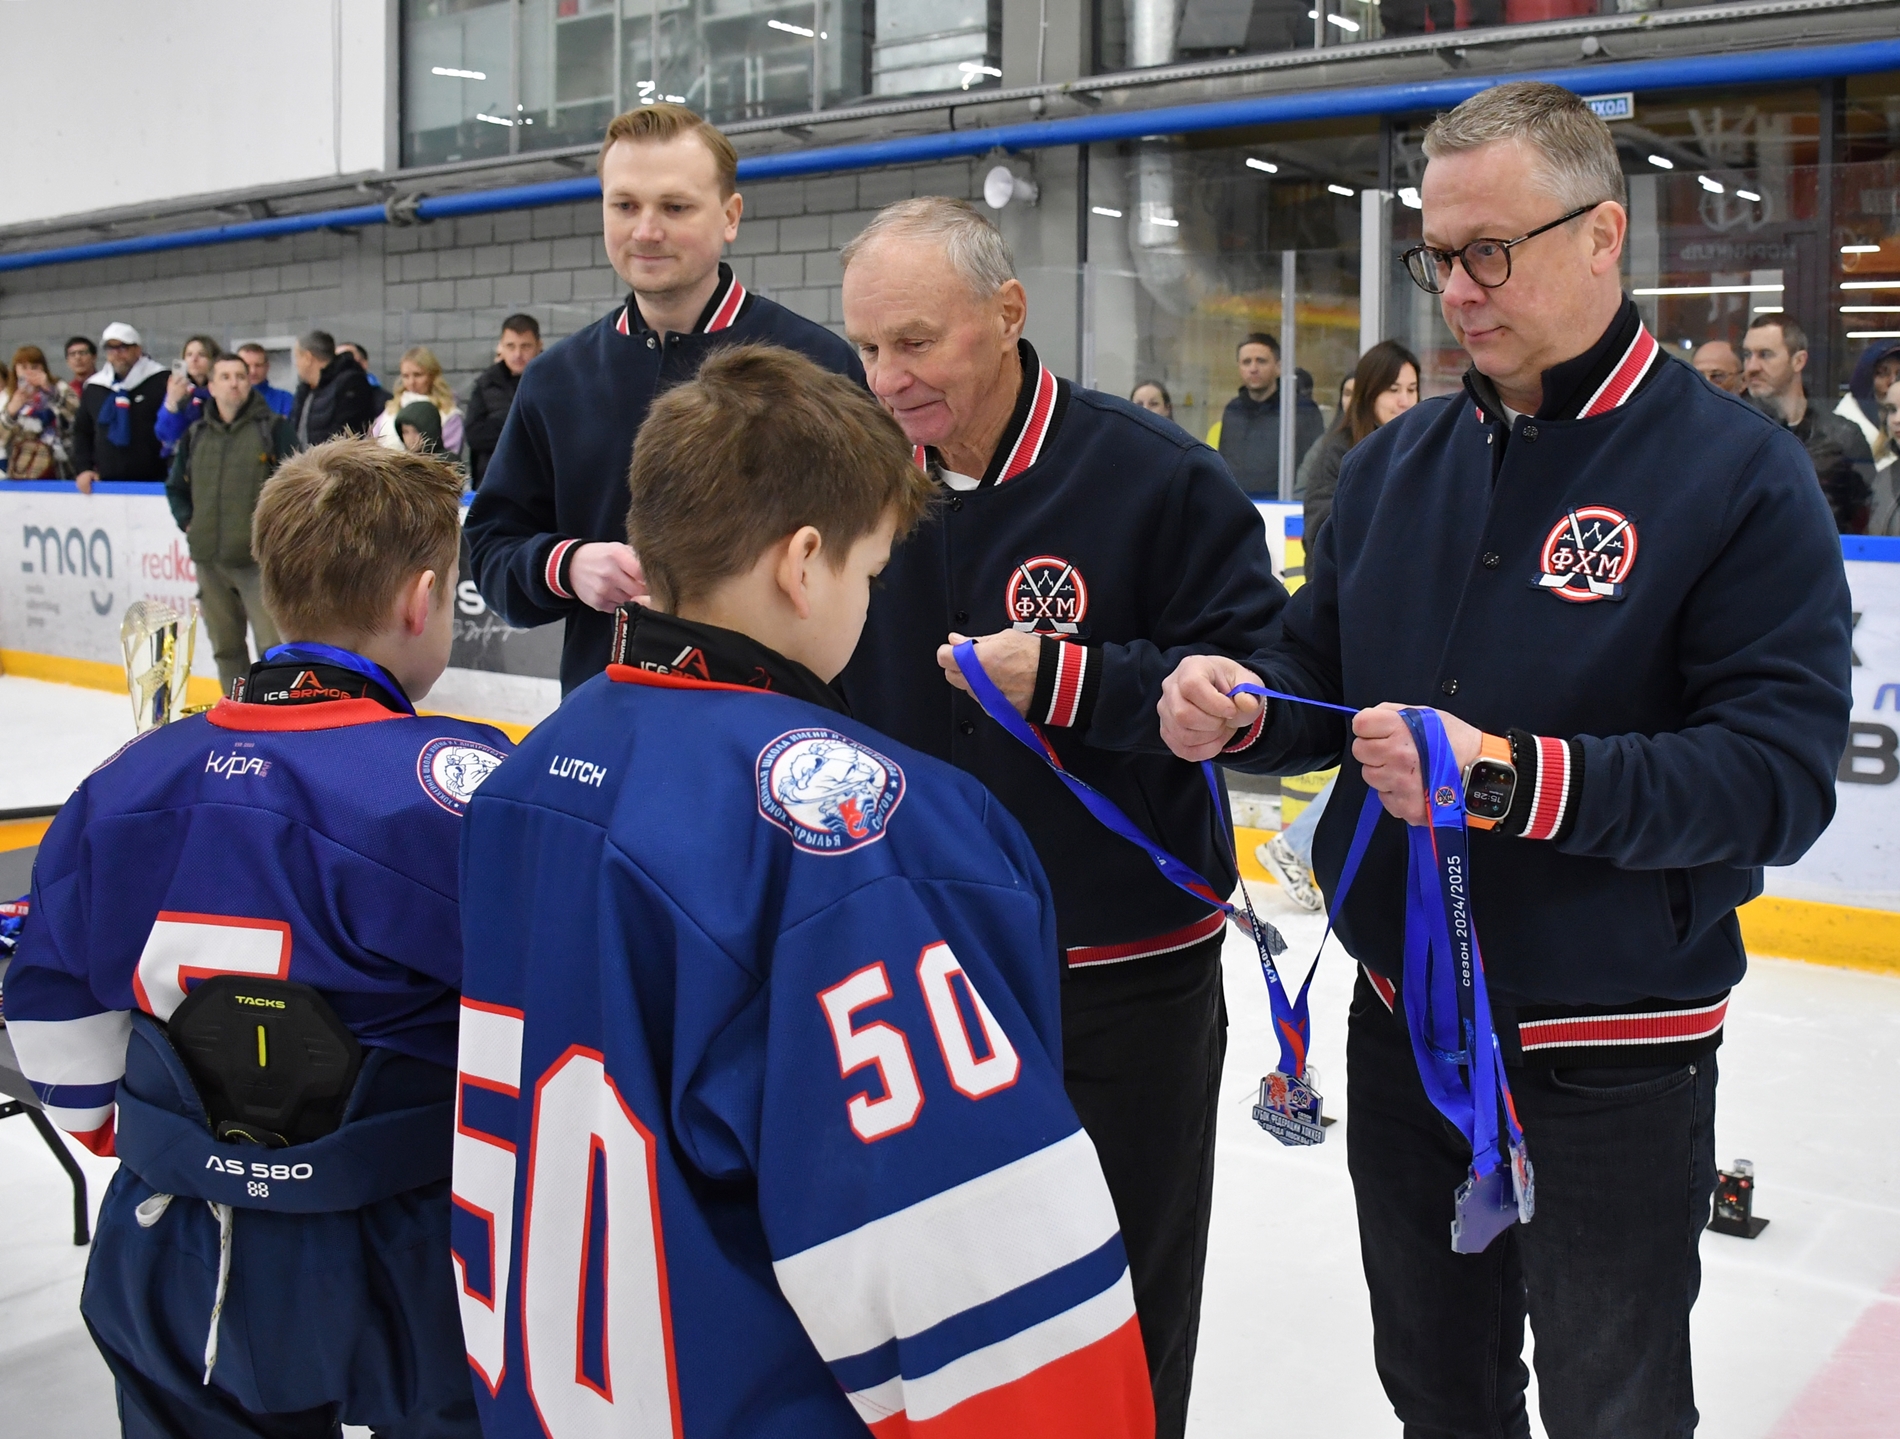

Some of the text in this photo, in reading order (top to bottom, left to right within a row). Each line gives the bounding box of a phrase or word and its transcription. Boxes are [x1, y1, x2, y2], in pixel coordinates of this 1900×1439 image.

[1591, 98, 1627, 115] ХОД
[22, 525, 113, 615] mag
[1551, 547, 1622, 578] ФХМ
[1015, 597, 1076, 617] ФХМ
[762, 740, 791, 768] ШКОЛА
[790, 731, 828, 743] ИМЕНИ
[549, 755, 607, 788] LUTCH
[794, 828, 842, 848] КРЫЛЬЯ
[1447, 855, 1471, 987] сезон 2024/2025
[1259, 944, 1278, 984] КУБОК
[235, 995, 286, 1009] TACKS
[816, 939, 1022, 1144] 50
[205, 1155, 313, 1180] AS 580
[451, 996, 684, 1439] 50
